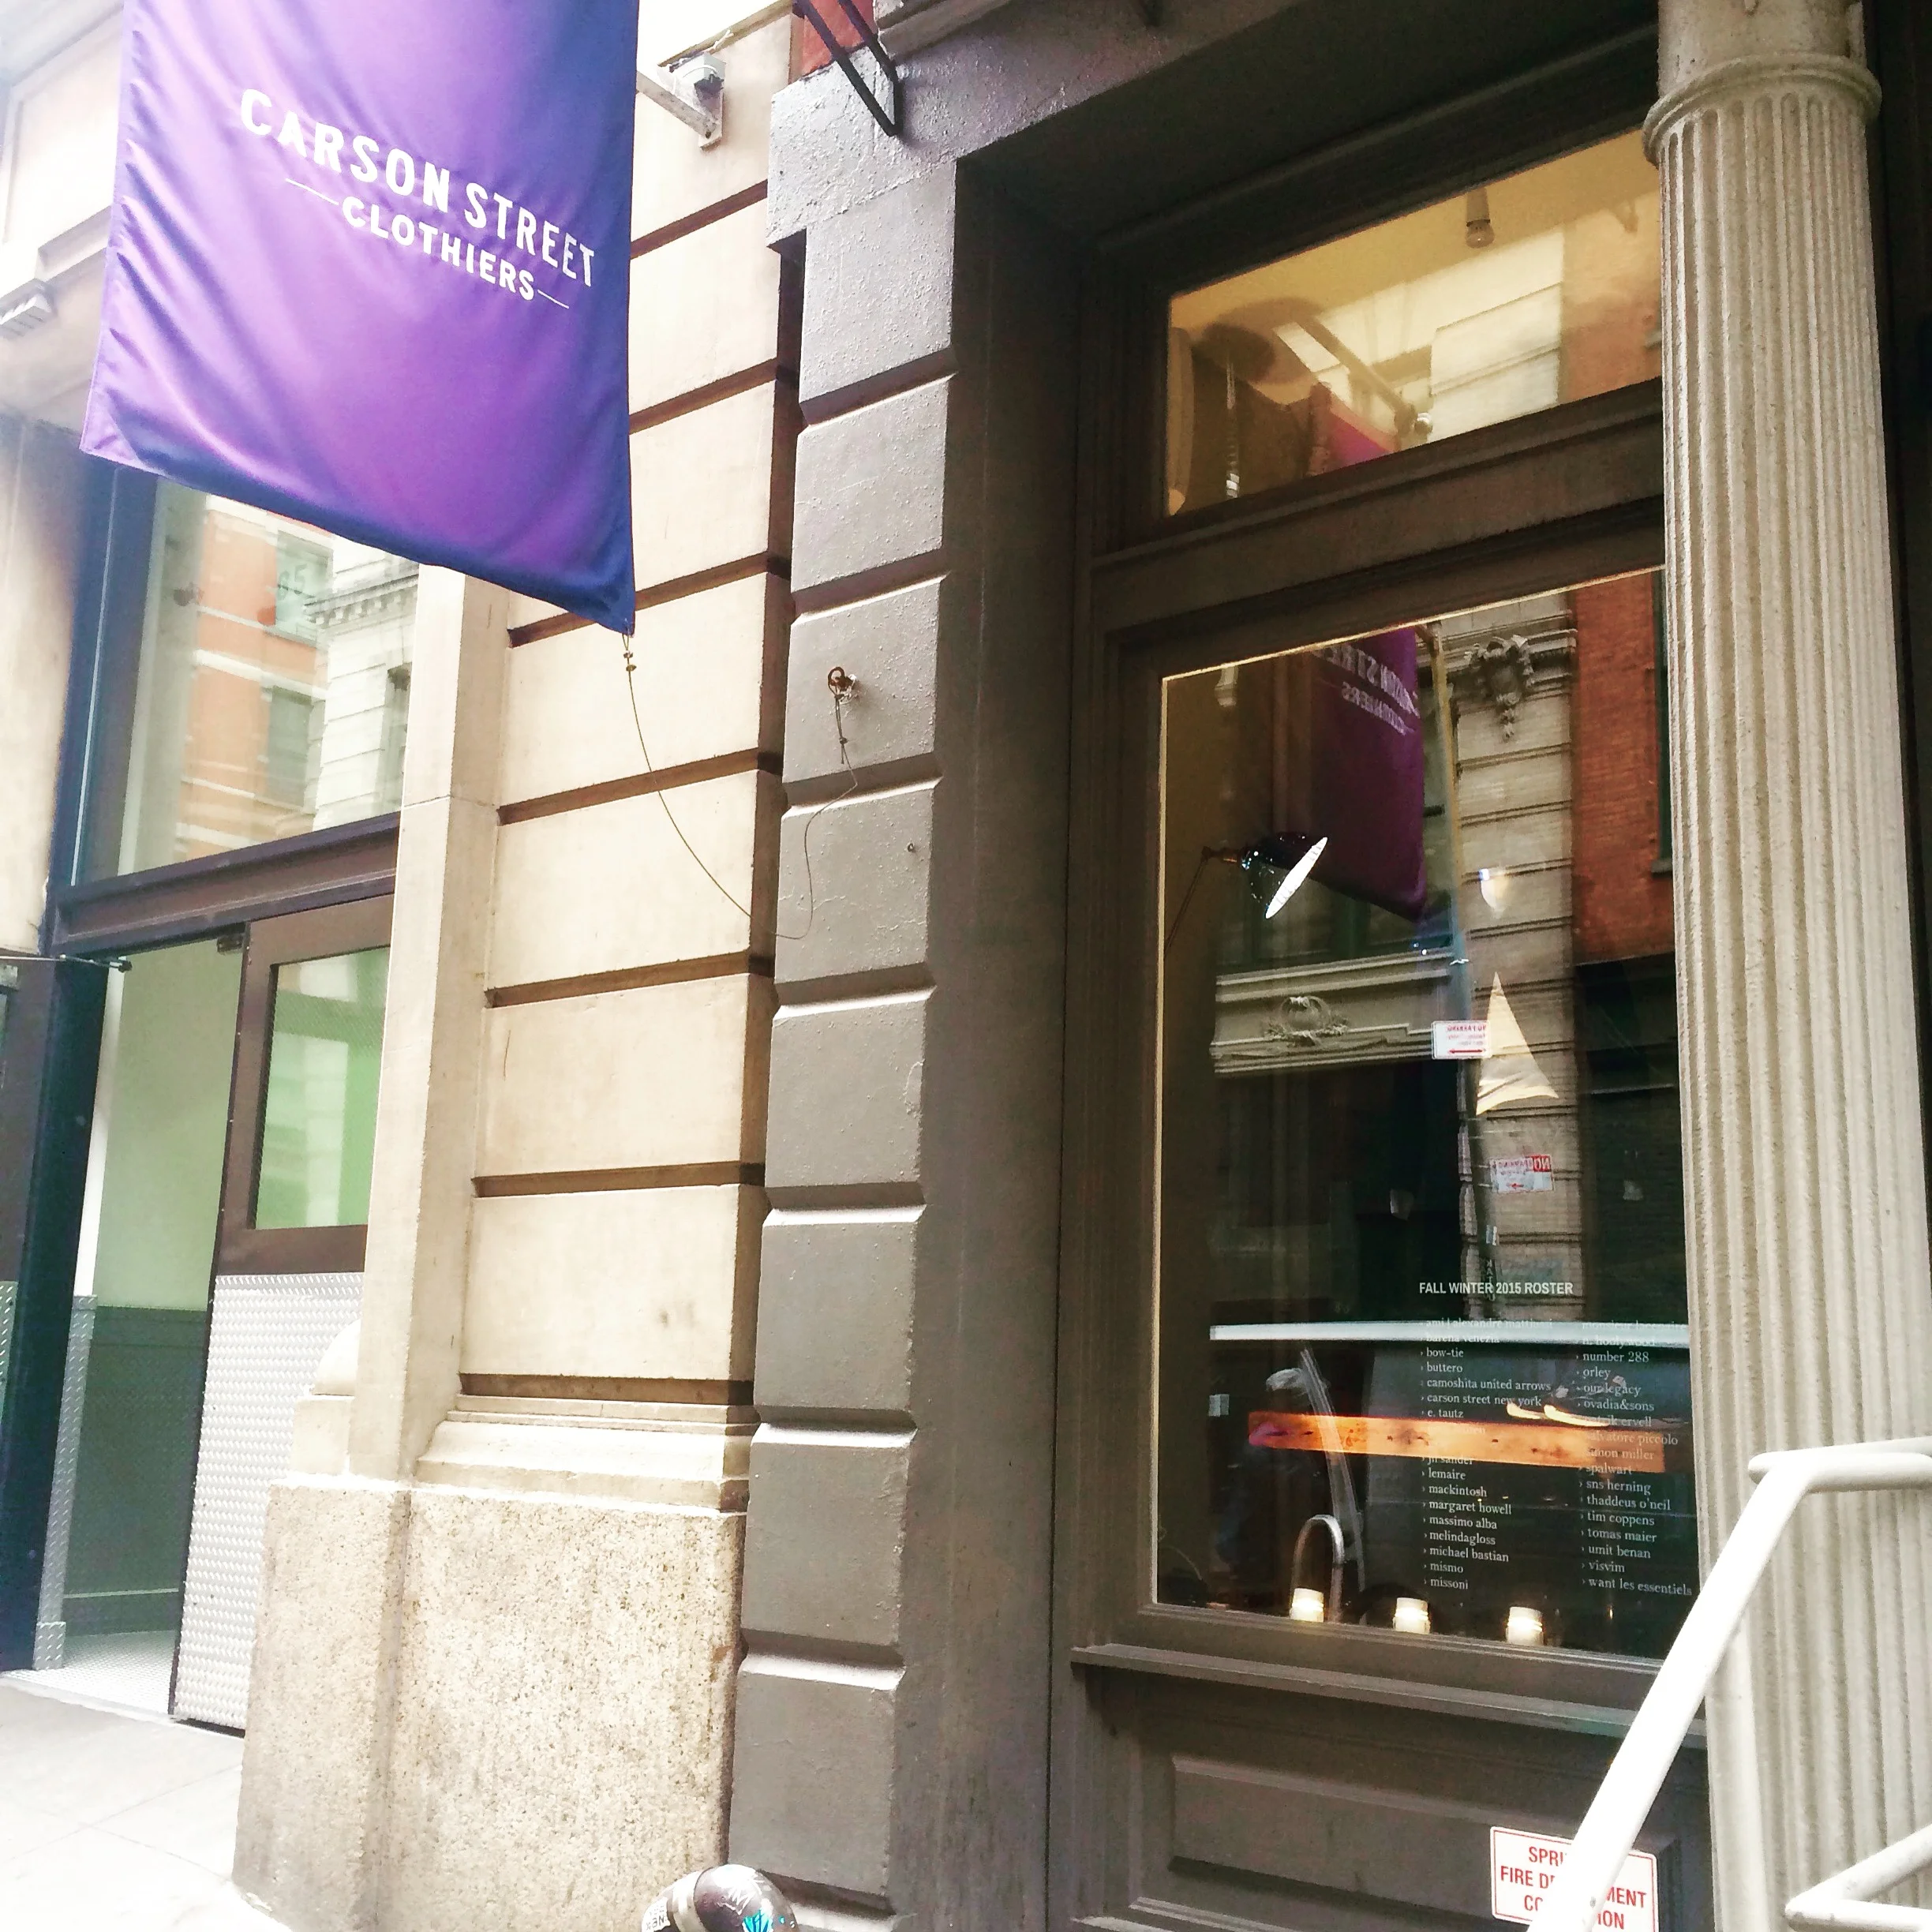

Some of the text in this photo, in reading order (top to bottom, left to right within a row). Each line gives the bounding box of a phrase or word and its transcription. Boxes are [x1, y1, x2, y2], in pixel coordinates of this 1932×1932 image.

[241, 88, 594, 286] CARSON STREET
[342, 196, 535, 301] CLOTHIERS
[1419, 1282, 1574, 1294] FALL WINTER 2015 ROSTER
[1426, 1346, 1464, 1357] bow-tie
[1582, 1350, 1649, 1363] number 288
[1426, 1361, 1463, 1372] buttero
[1582, 1366, 1611, 1380] orley
[1427, 1377, 1552, 1391] camoshita united arrows
[1604, 1383, 1642, 1397] legacy
[1427, 1395, 1542, 1408] carson street new york
[1583, 1398, 1655, 1412] ovadia&sons
[1438, 1408, 1464, 1418] tautz
[1620, 1416, 1652, 1428] ervell
[1638, 1432, 1679, 1446] piccolo
[1622, 1448, 1655, 1460] miller
[1428, 1467, 1466, 1481] lemaire
[1586, 1462, 1632, 1475] spalwart
[1428, 1484, 1488, 1498] mackintosh
[1586, 1479, 1652, 1496] sns herning
[1428, 1500, 1512, 1515] margaret howell
[1586, 1494, 1672, 1511] thaddeus o'neil
[1429, 1515, 1498, 1530] massimo alba
[1587, 1511, 1655, 1527] tim coppens
[1429, 1530, 1496, 1546] melindagloss
[1587, 1528, 1657, 1543] tomas maier
[1429, 1545, 1510, 1563] michael bastian
[1588, 1544, 1652, 1559] umit benan
[1430, 1561, 1464, 1574] mismo
[1588, 1559, 1626, 1573] visvim
[1430, 1576, 1469, 1590] missoni
[1588, 1578, 1693, 1596] want les essentiels
[1500, 1865, 1534, 1887] FIRE
